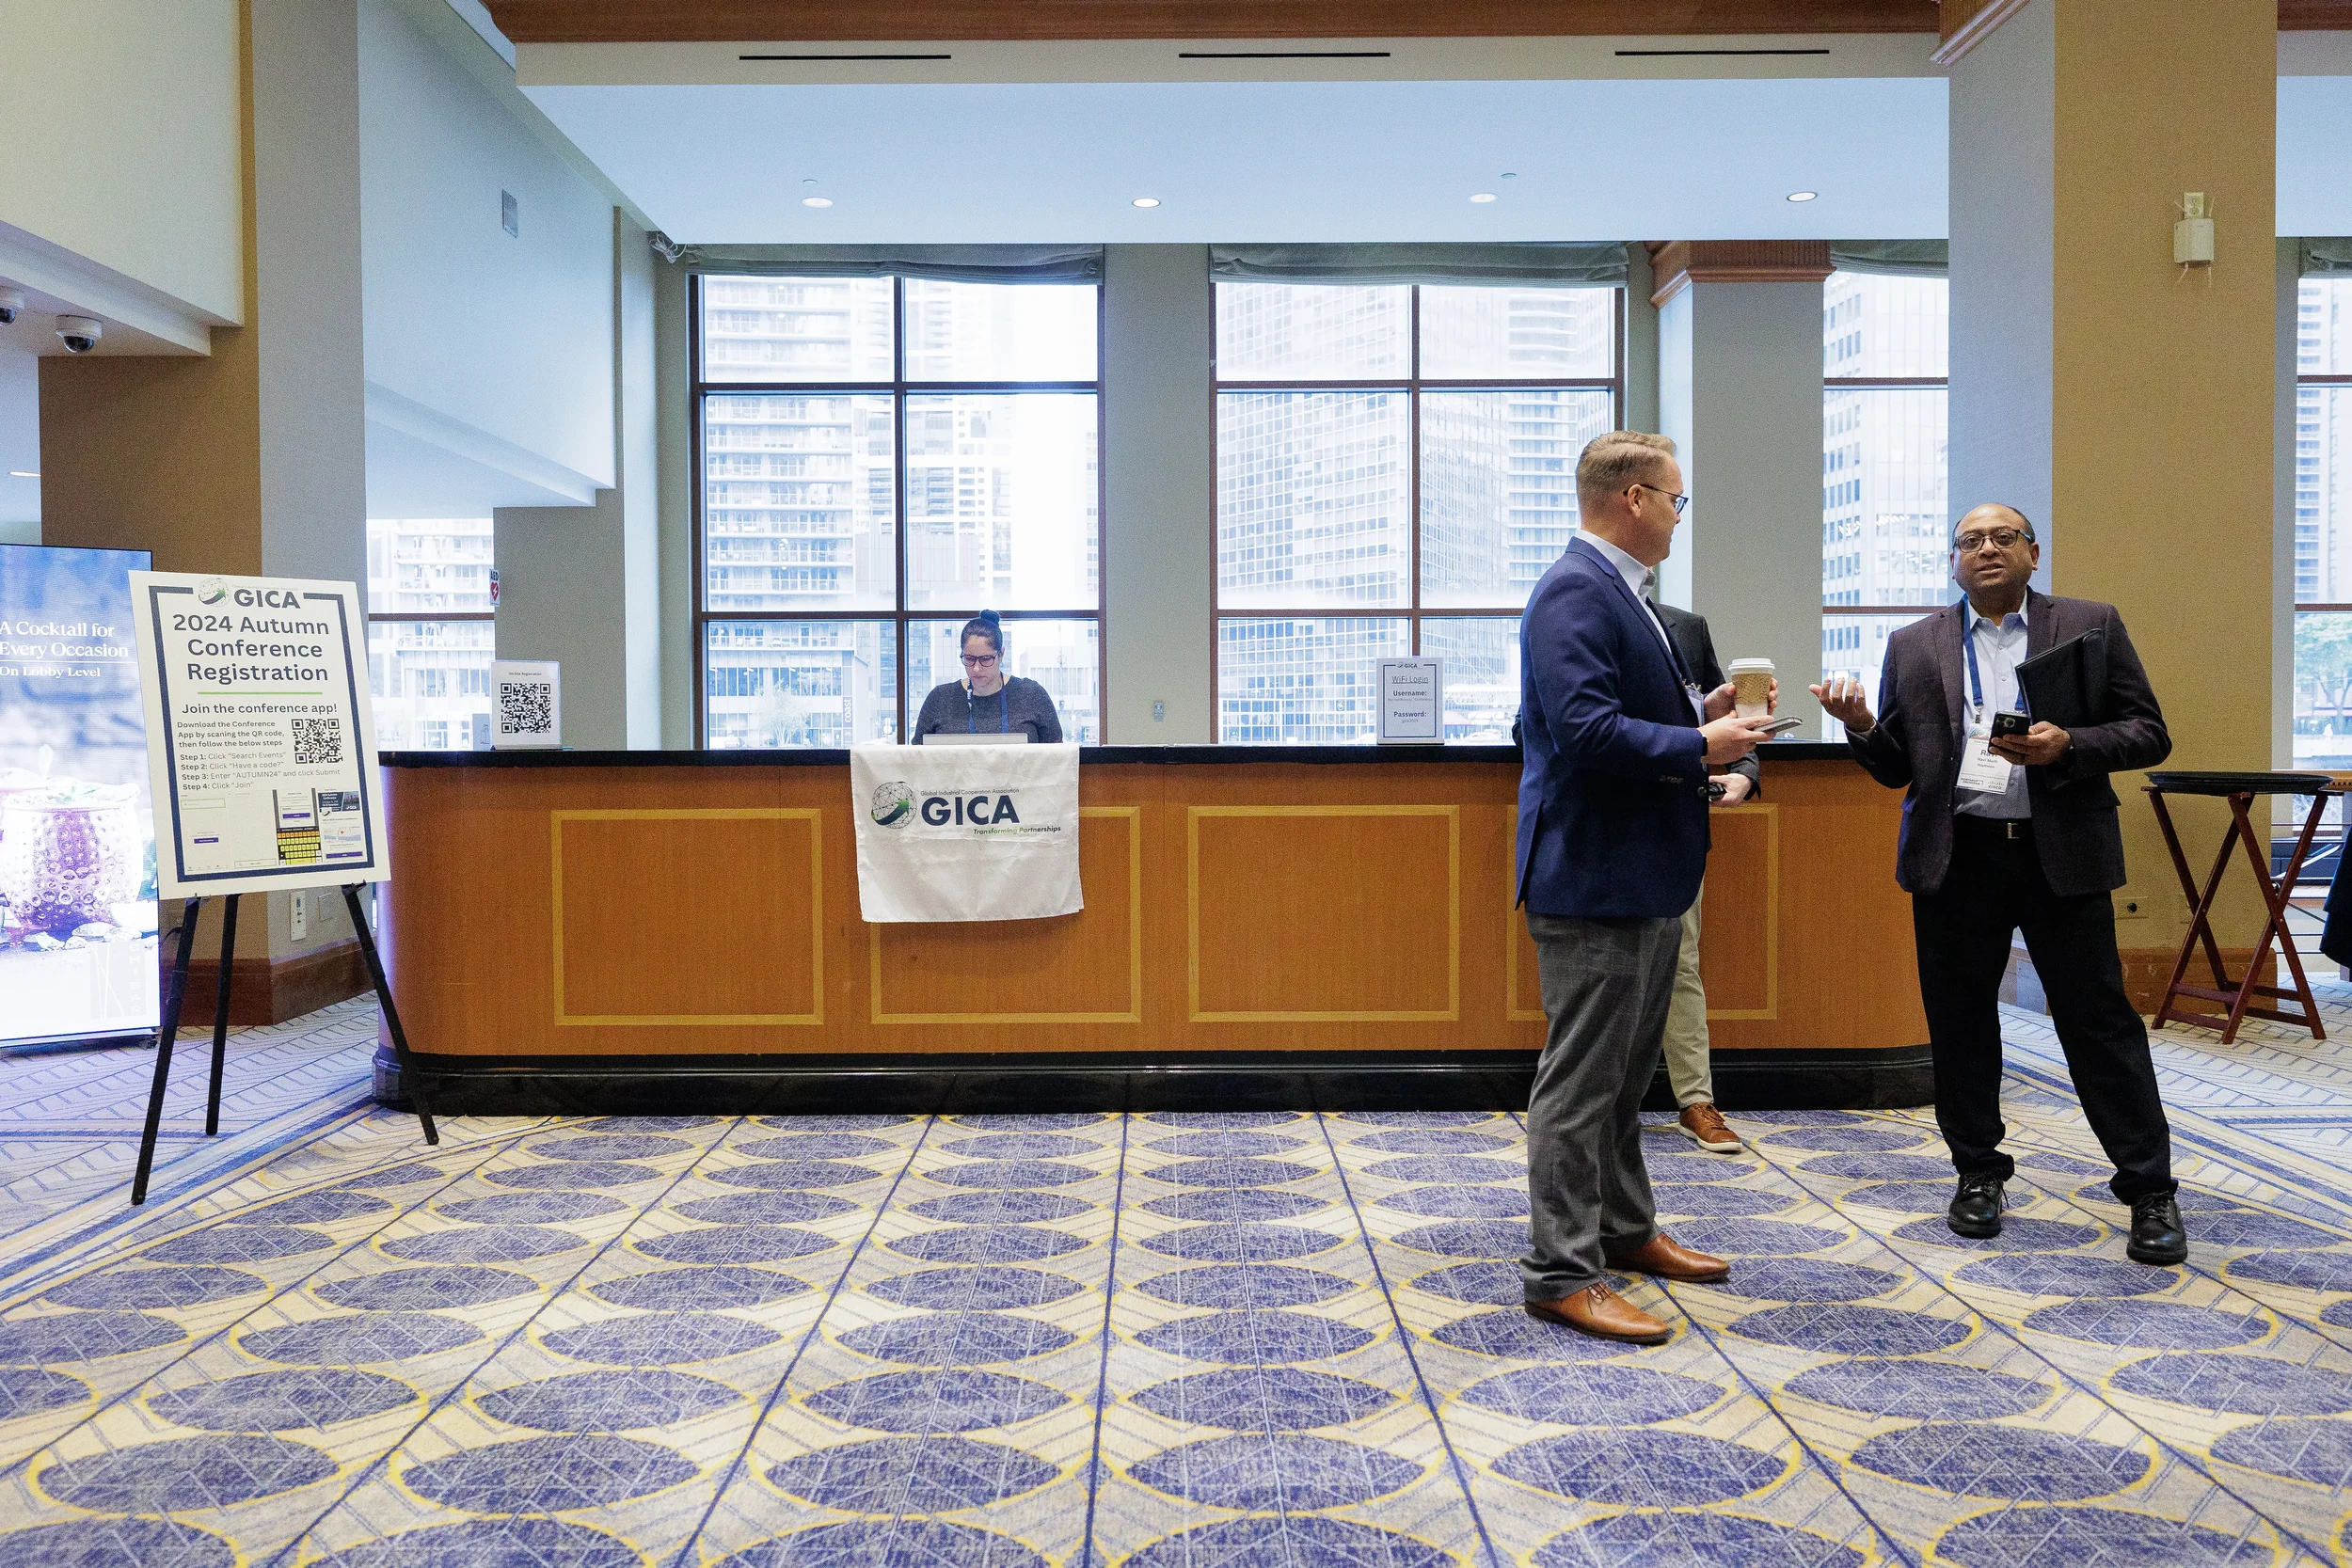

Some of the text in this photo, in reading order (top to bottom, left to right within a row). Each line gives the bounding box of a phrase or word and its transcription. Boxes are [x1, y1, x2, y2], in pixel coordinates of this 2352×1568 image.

[234, 589, 301, 609] GICA
[0, 621, 115, 637] A Cocktail for
[173, 614, 329, 634] 2024 Autumn
[0, 641, 129, 659] Every Occasion
[188, 639, 322, 657] Conference
[0, 666, 101, 678] On Lobby Level
[188, 663, 328, 685] Registration
[182, 703, 337, 715] Join the conference app!
[921, 795, 1020, 826] GICA
